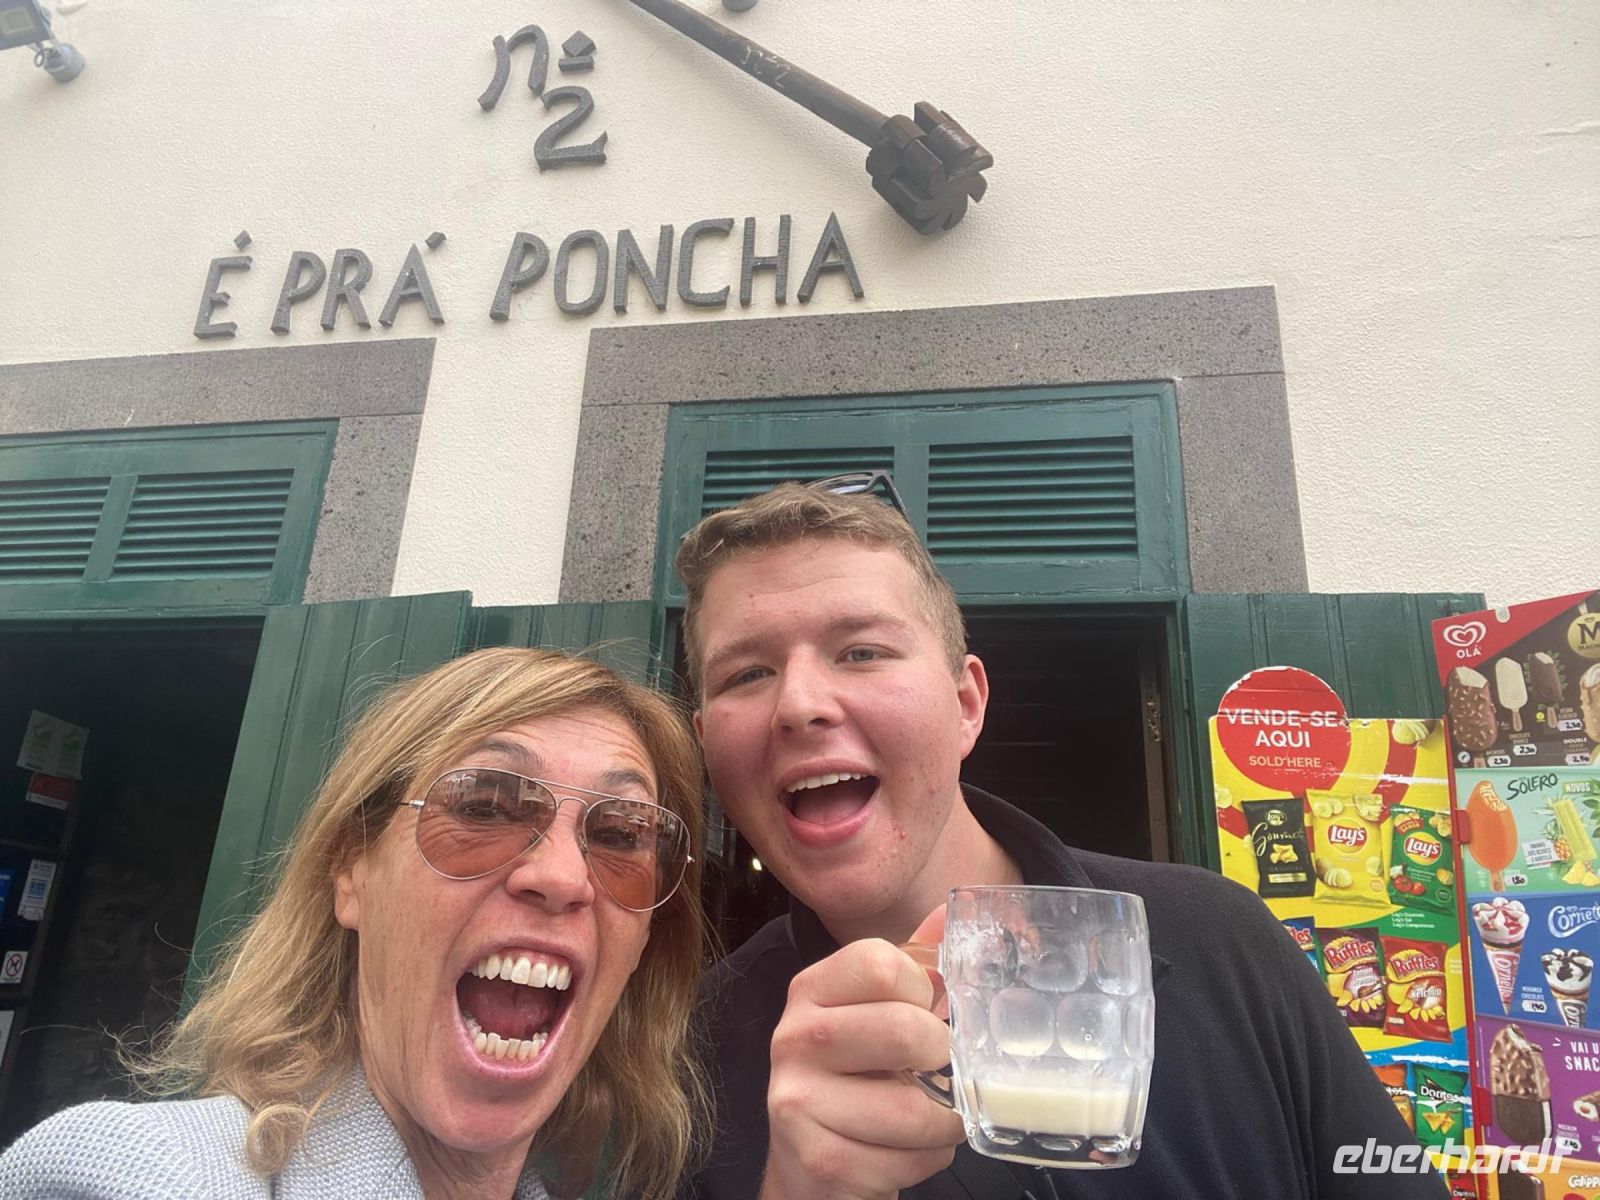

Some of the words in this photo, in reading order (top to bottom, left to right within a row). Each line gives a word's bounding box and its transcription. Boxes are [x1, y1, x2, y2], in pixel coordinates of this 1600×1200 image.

[534, 85, 609, 174] 2
[194, 230, 252, 339] É
[271, 231, 447, 336] PRÁ
[489, 211, 864, 322] PONCHA
[1456, 645, 1482, 659] OLÁ
[1223, 708, 1338, 728] VENDE-SE
[1255, 730, 1311, 748] AQUI
[1249, 755, 1284, 767] SOLD
[1287, 757, 1322, 768] HERE
[1506, 773, 1558, 801] SOLERO
[1330, 825, 1365, 846] Lay's
[1407, 838, 1440, 858] Lay's
[1324, 940, 1377, 969] Ruffles
[1391, 955, 1440, 979] Ruffles
[1570, 1041, 1589, 1054] VAI
[1564, 1055, 1600, 1072] SNAC
